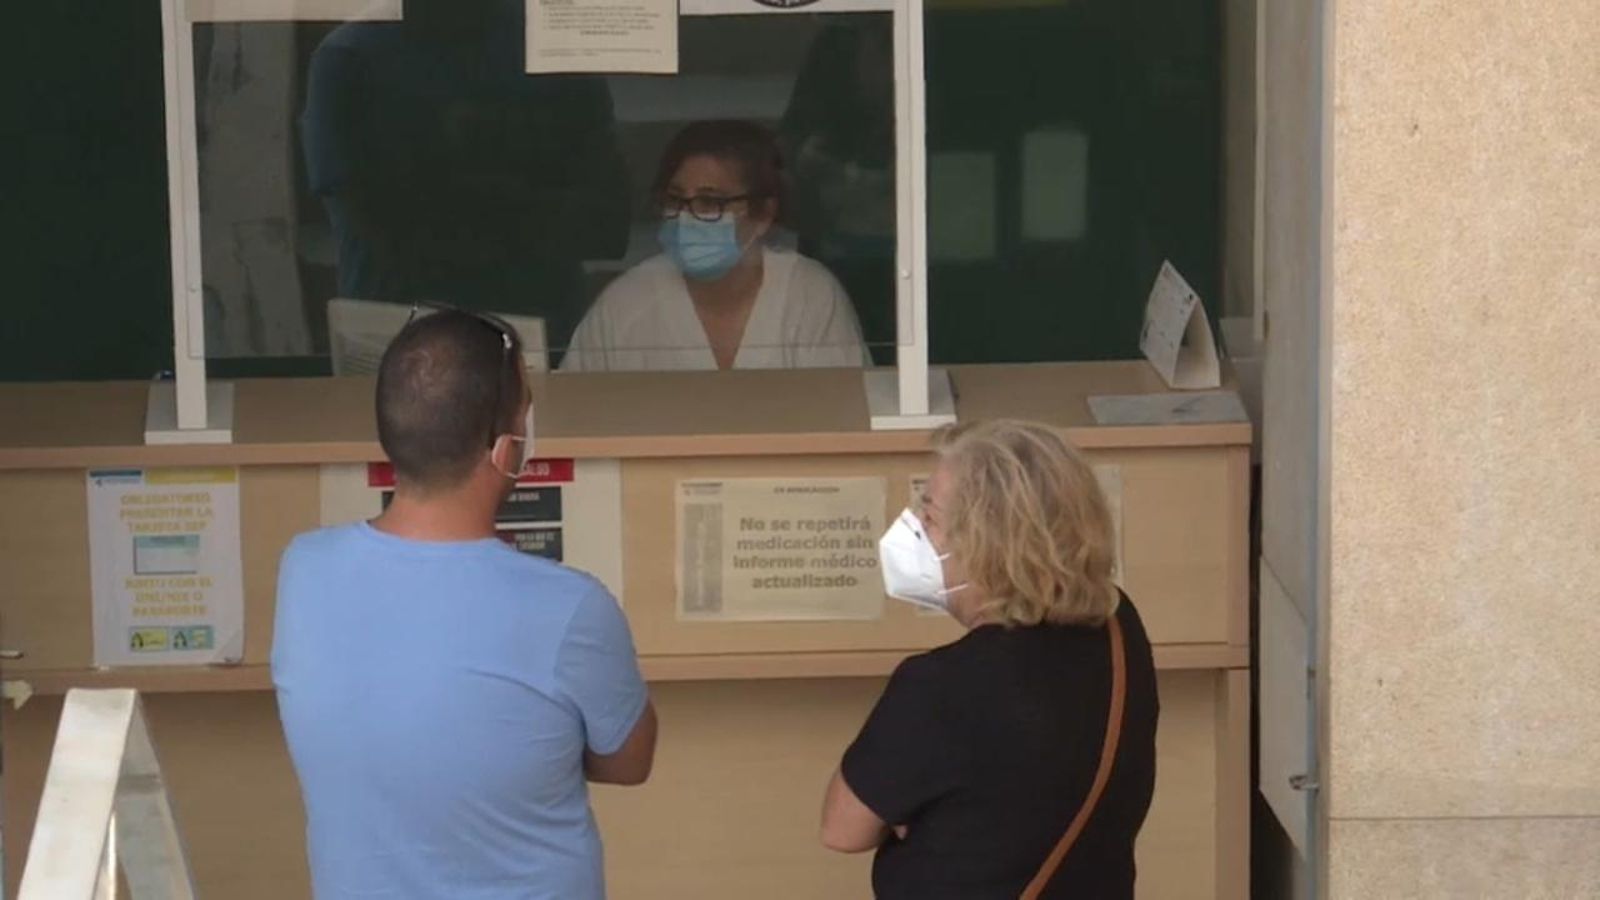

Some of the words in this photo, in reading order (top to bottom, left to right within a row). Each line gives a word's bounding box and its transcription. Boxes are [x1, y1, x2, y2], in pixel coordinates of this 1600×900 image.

[739, 517, 765, 531] No
[771, 520, 790, 531] se
[797, 515, 871, 533] repetirá
[737, 535, 841, 550] medicación
[846, 536, 874, 549] sin
[810, 553, 877, 569] médico
[752, 573, 858, 588] actualizado
